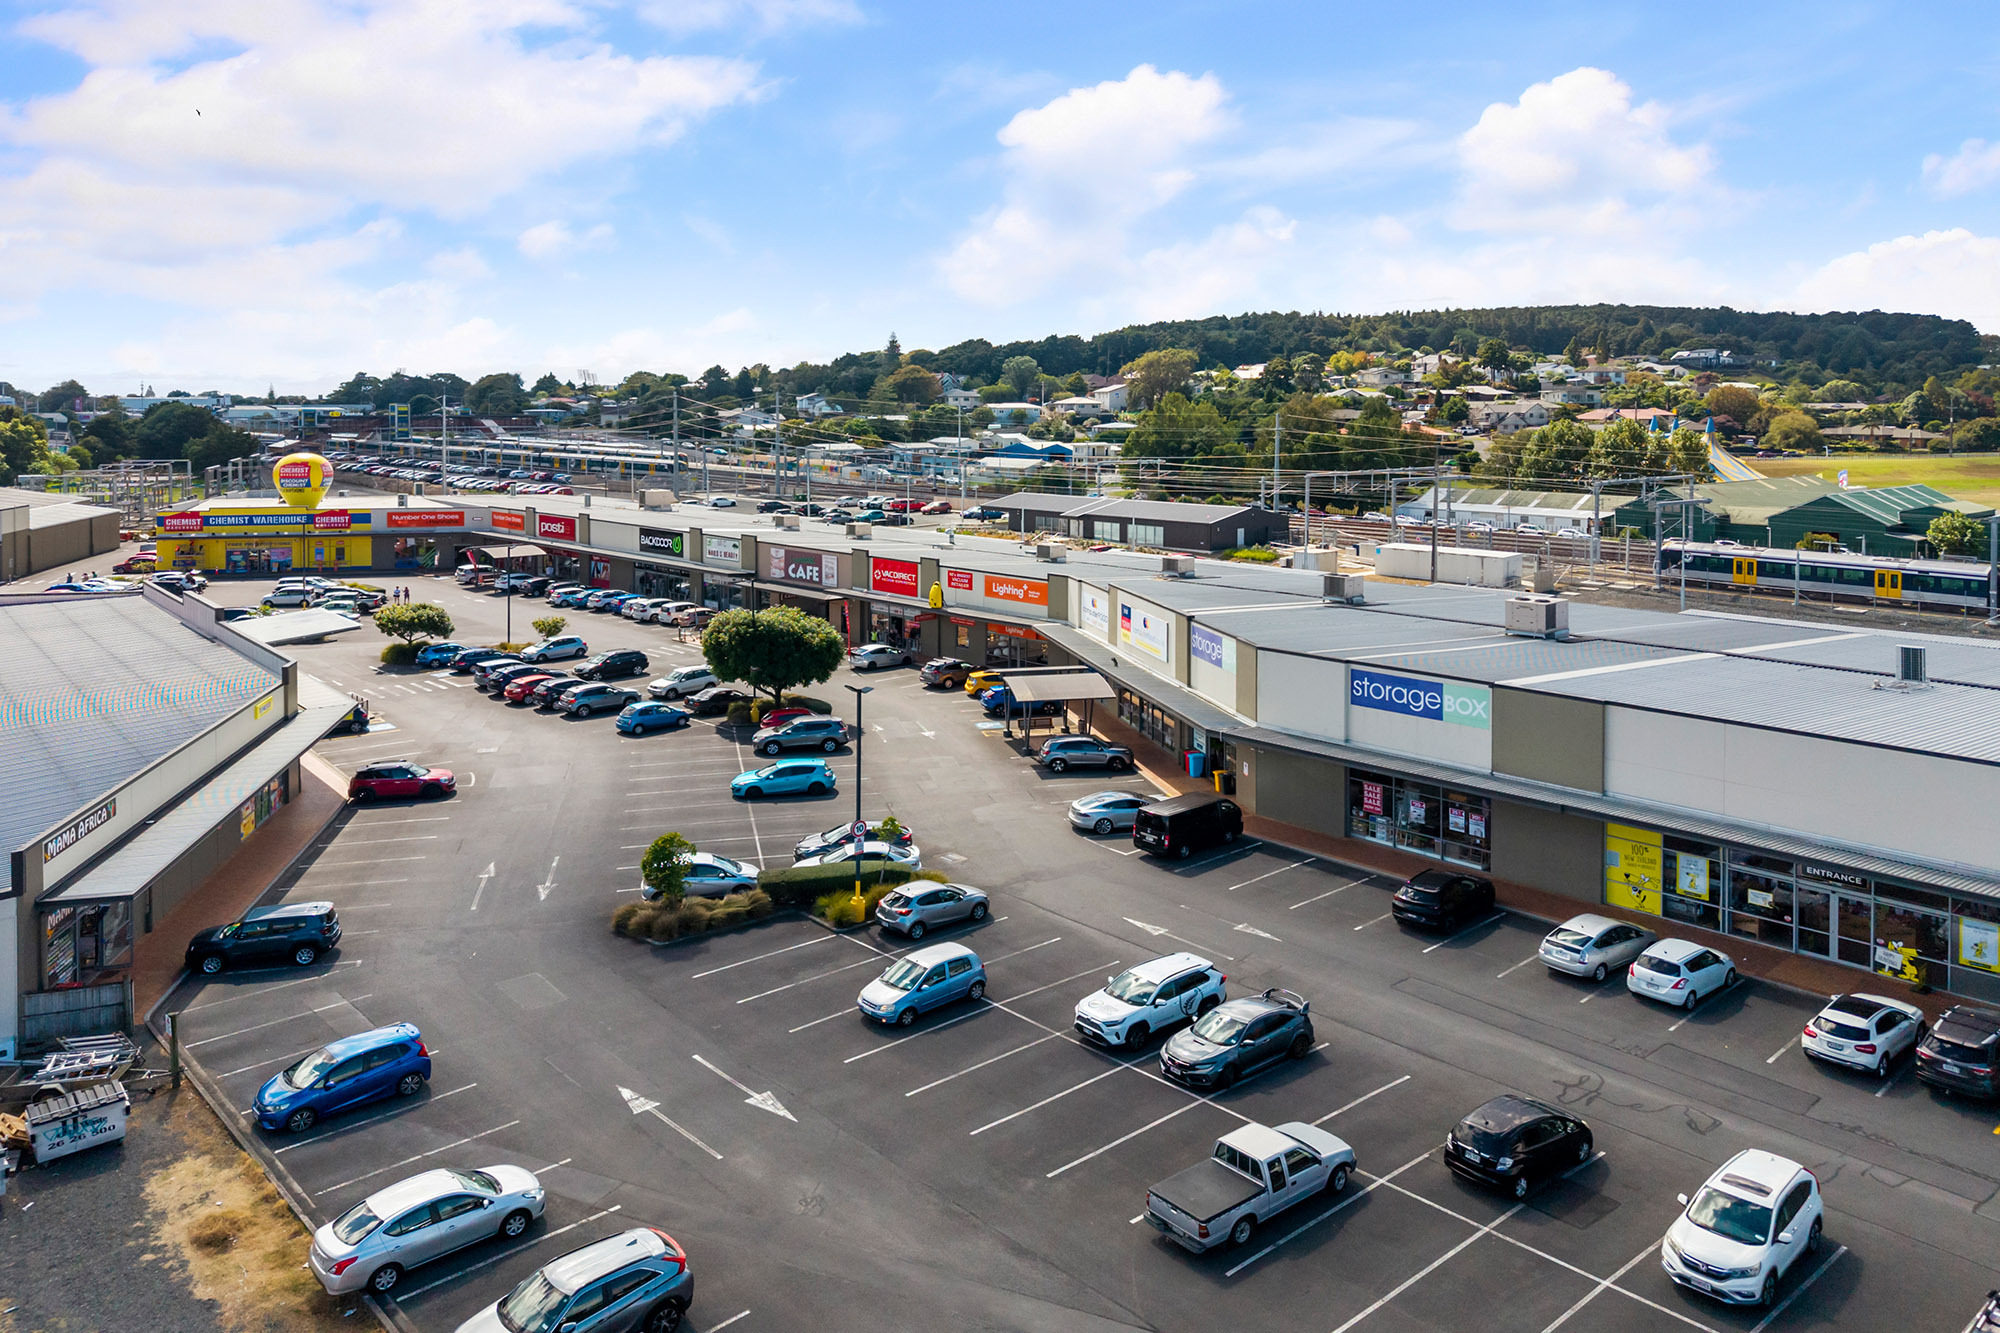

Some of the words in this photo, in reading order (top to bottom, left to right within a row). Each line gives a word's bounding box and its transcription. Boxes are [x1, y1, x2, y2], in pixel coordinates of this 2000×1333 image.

[209, 516, 250, 524] CHEMIST
[252, 516, 307, 524] WAREHOUSE
[541, 522, 564, 533] posti
[640, 535, 672, 548] BACKDOOR
[788, 563, 819, 582] CAFE
[881, 570, 916, 582] VACDIRECT
[1192, 632, 1222, 660] storage
[1353, 678, 1440, 712] storage
[1444, 694, 1487, 718] BOX
[1364, 784, 1380, 793] SALE
[1364, 791, 1380, 800] SALE
[1364, 798, 1380, 806] SALE
[48, 827, 76, 856] MAMA
[78, 808, 107, 838] AFRICA
[856, 824, 864, 833] 10
[1806, 866, 1862, 884] ENTRANCE
[48, 1140, 65, 1151] 26
[70, 1134, 86, 1144] 26
[91, 1124, 116, 1137] 500
